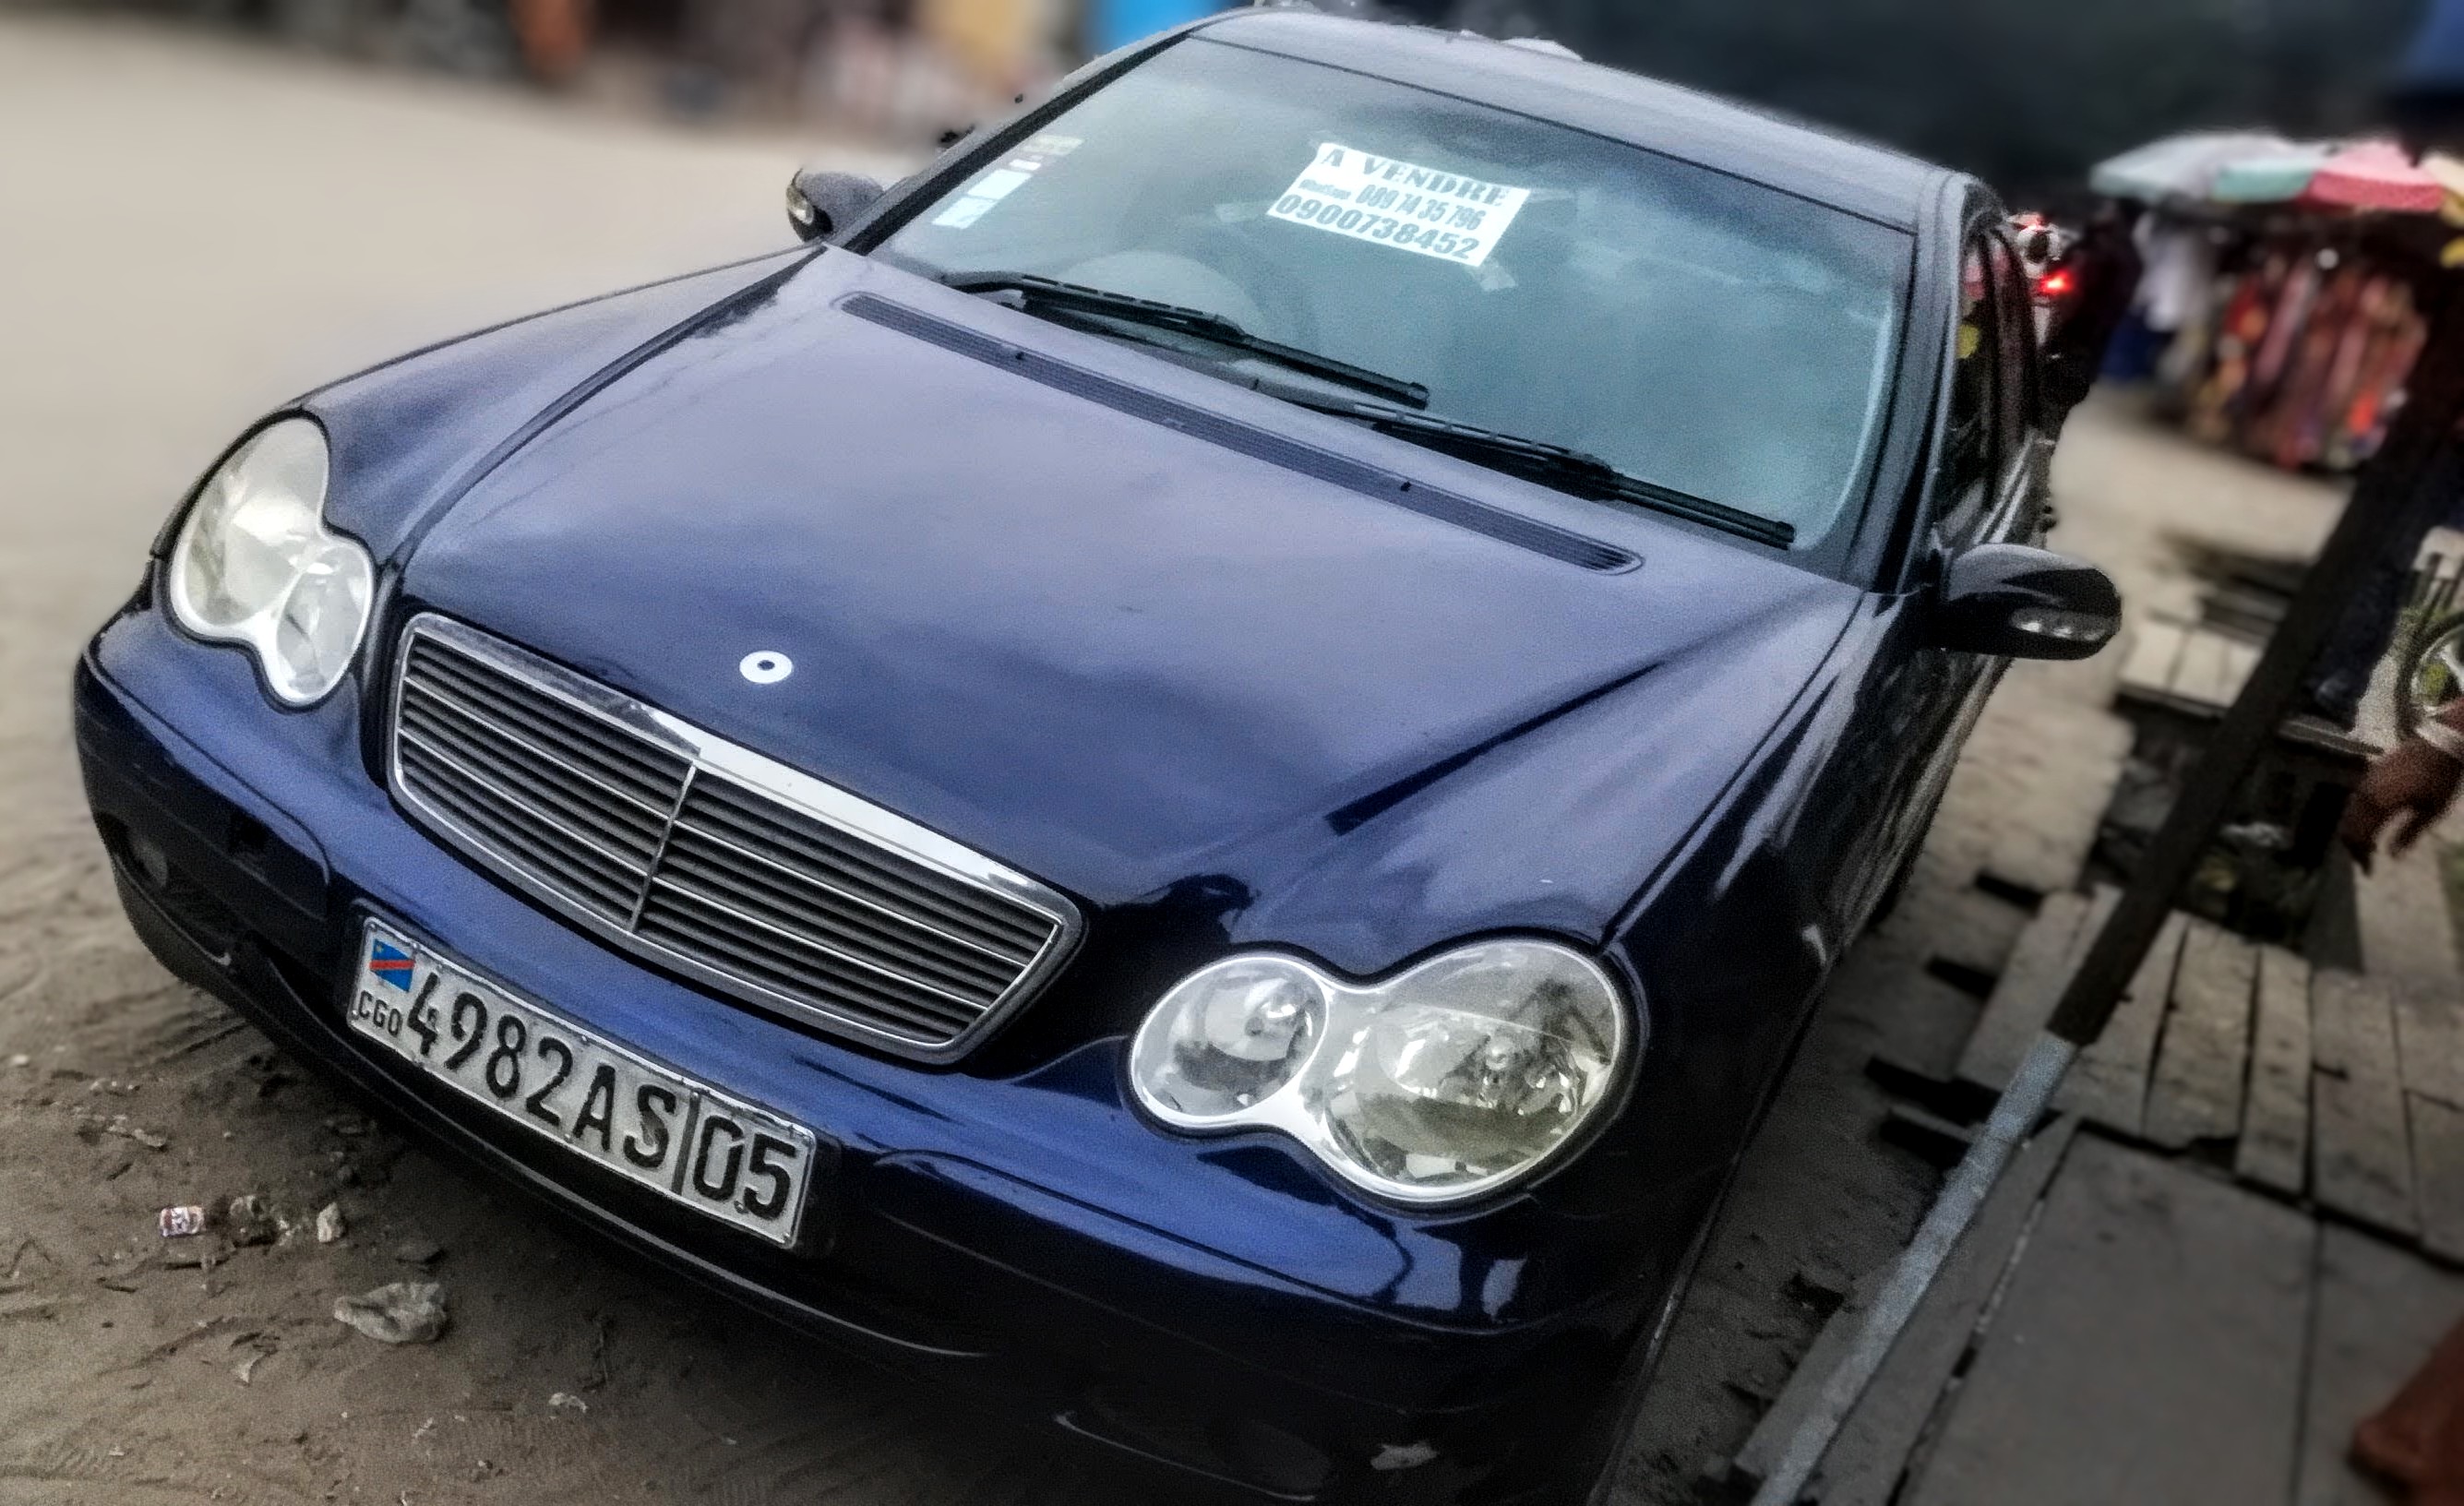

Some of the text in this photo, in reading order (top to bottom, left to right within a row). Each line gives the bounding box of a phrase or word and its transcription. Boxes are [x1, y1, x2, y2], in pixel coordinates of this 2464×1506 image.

[1322, 149, 1346, 167] A
[1361, 156, 1512, 207] VENDRE
[1276, 194, 1480, 259] 0900738452
[1417, 199, 1449, 221] 35
[359, 990, 402, 1037] CGO
